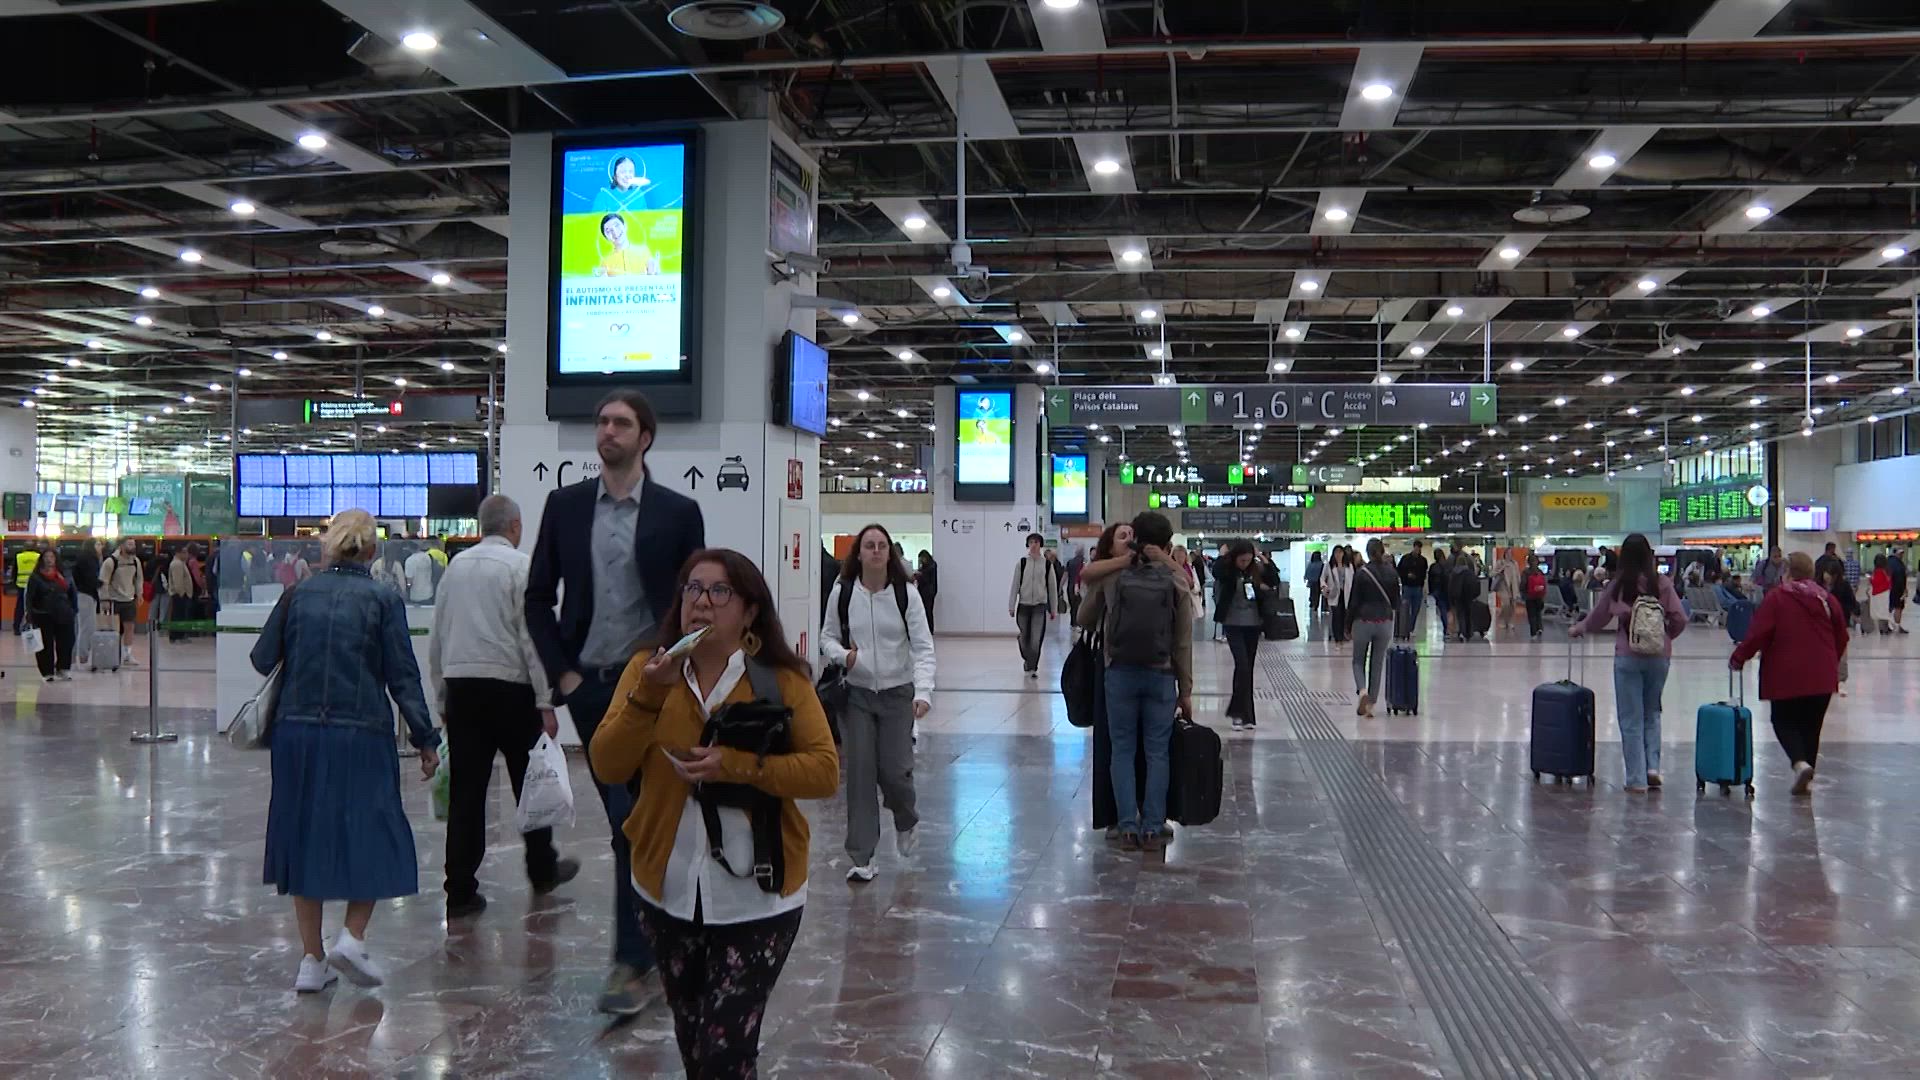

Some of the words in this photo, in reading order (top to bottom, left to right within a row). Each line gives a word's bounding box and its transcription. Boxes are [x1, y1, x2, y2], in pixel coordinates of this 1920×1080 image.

[576, 286, 612, 294] AUTISMO
[625, 284, 664, 292] PRESENTA
[565, 294, 623, 306] INFINITAS
[1074, 392, 1097, 402] Plaça
[1098, 391, 1116, 401] dels
[1343, 391, 1372, 401] Acceso
[1102, 402, 1139, 411] Catalans
[1232, 391, 1249, 419] 1
[1254, 407, 1264, 419] a
[1270, 391, 1289, 419] 6
[1320, 391, 1336, 419] C
[1343, 401, 1368, 411] Accés
[557, 460, 574, 489] C
[1145, 465, 1156, 482] 7
[1165, 465, 1187, 483] 14
[1318, 466, 1328, 482] C
[1439, 503, 1464, 511] Acceso
[1554, 497, 1597, 506] acerca
[1468, 502, 1483, 529] C
